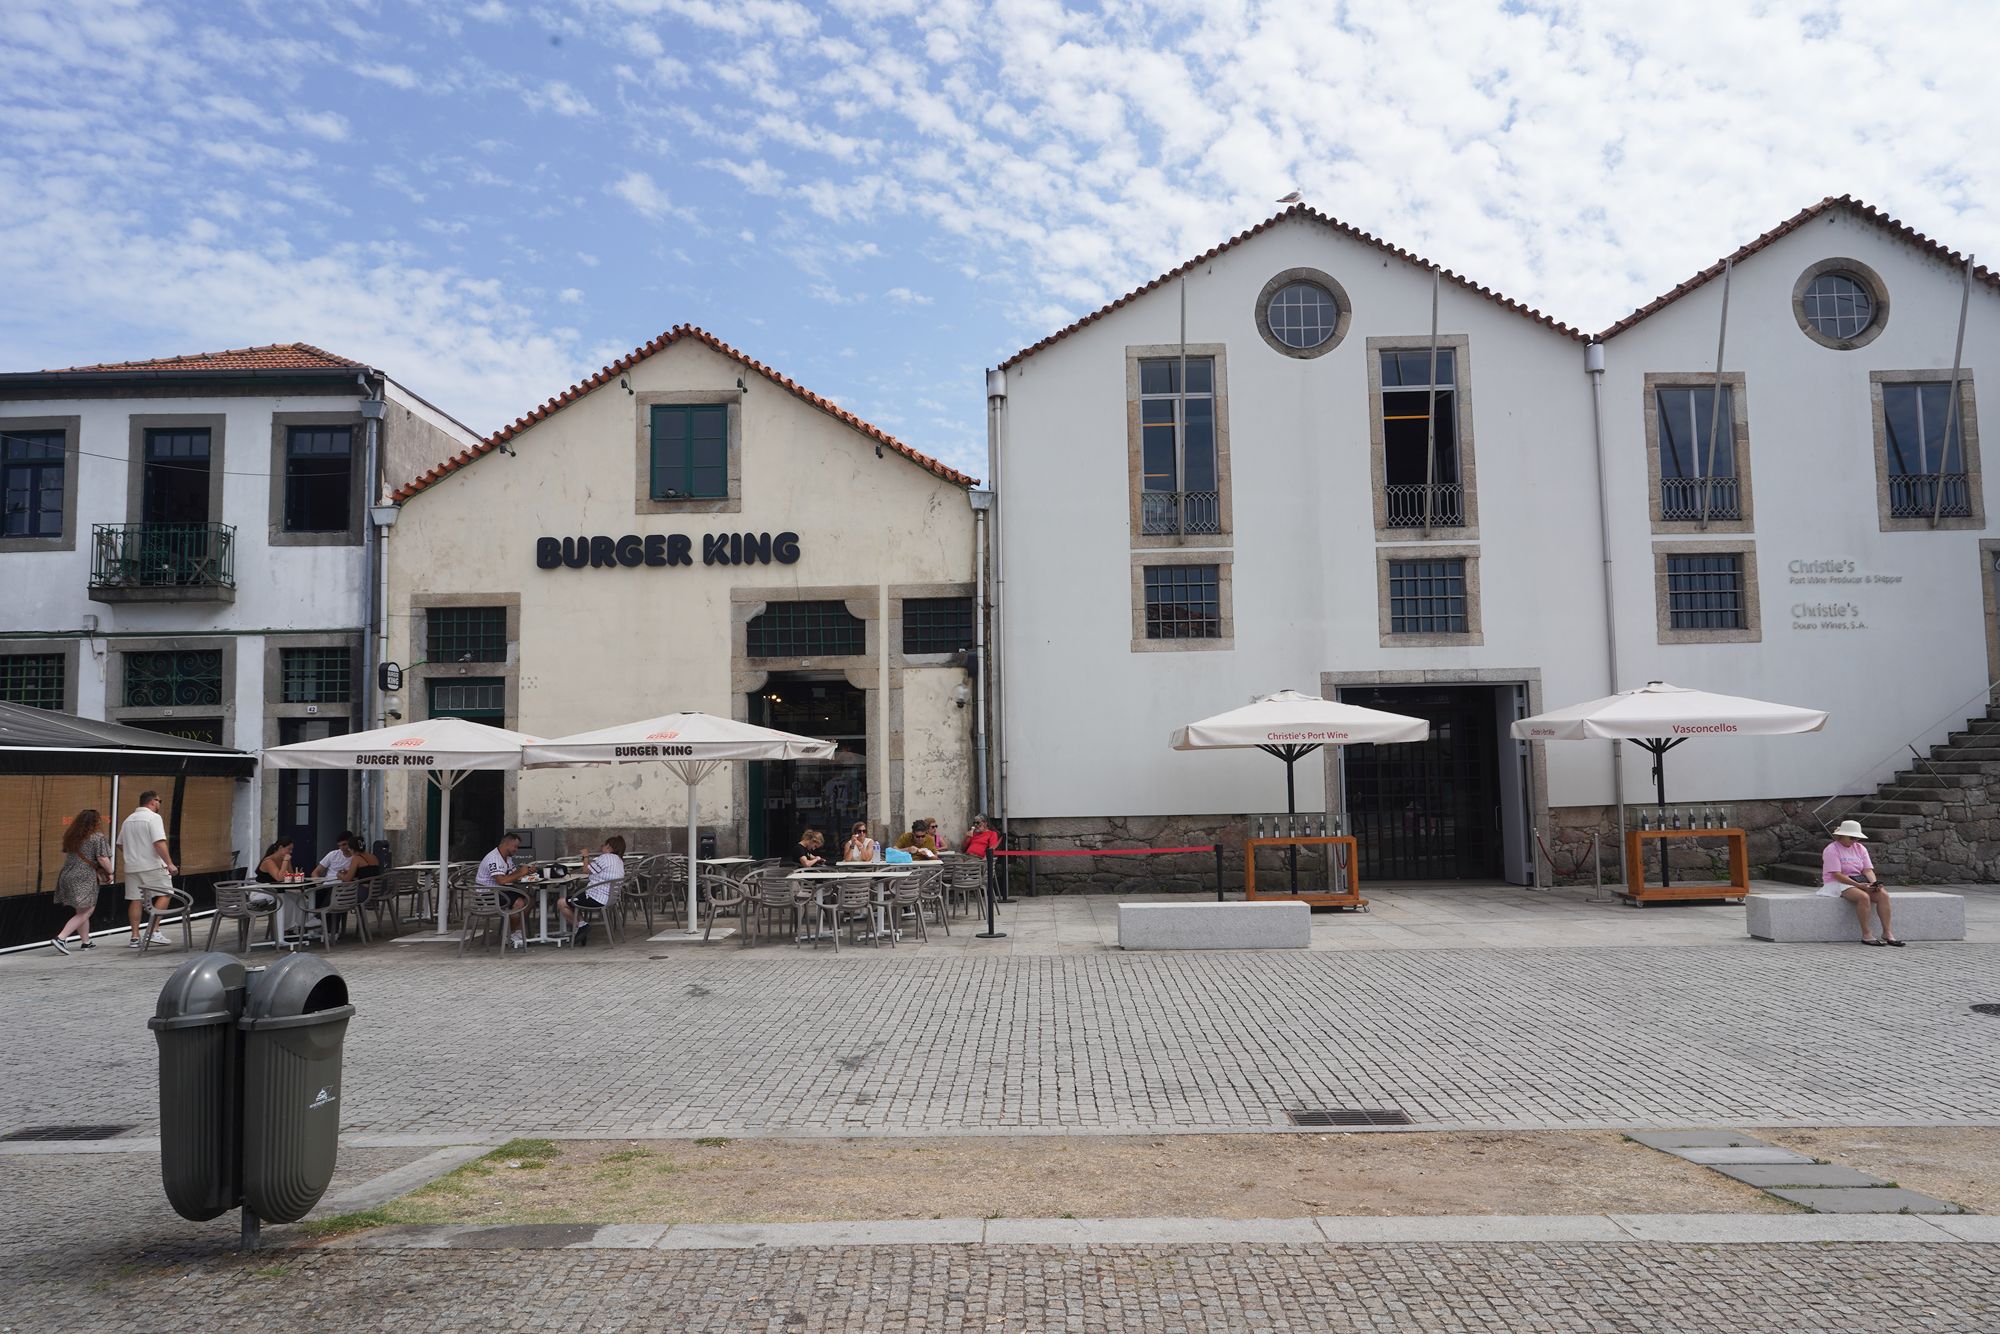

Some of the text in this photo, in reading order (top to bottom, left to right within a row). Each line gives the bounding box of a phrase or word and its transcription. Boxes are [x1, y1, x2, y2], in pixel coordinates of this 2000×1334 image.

[536, 532, 801, 569] BURGER KING
[1788, 560, 1855, 573] Christie's
[1791, 602, 1858, 618] Christie's
[1792, 622, 1817, 630] Douro
[1672, 723, 1738, 734] Vasconcellos
[1267, 731, 1349, 740] Christie's Port Wine
[615, 745, 693, 756] BURGER KING
[356, 755, 434, 765] BURGER KING
[488, 862, 497, 871] 23
